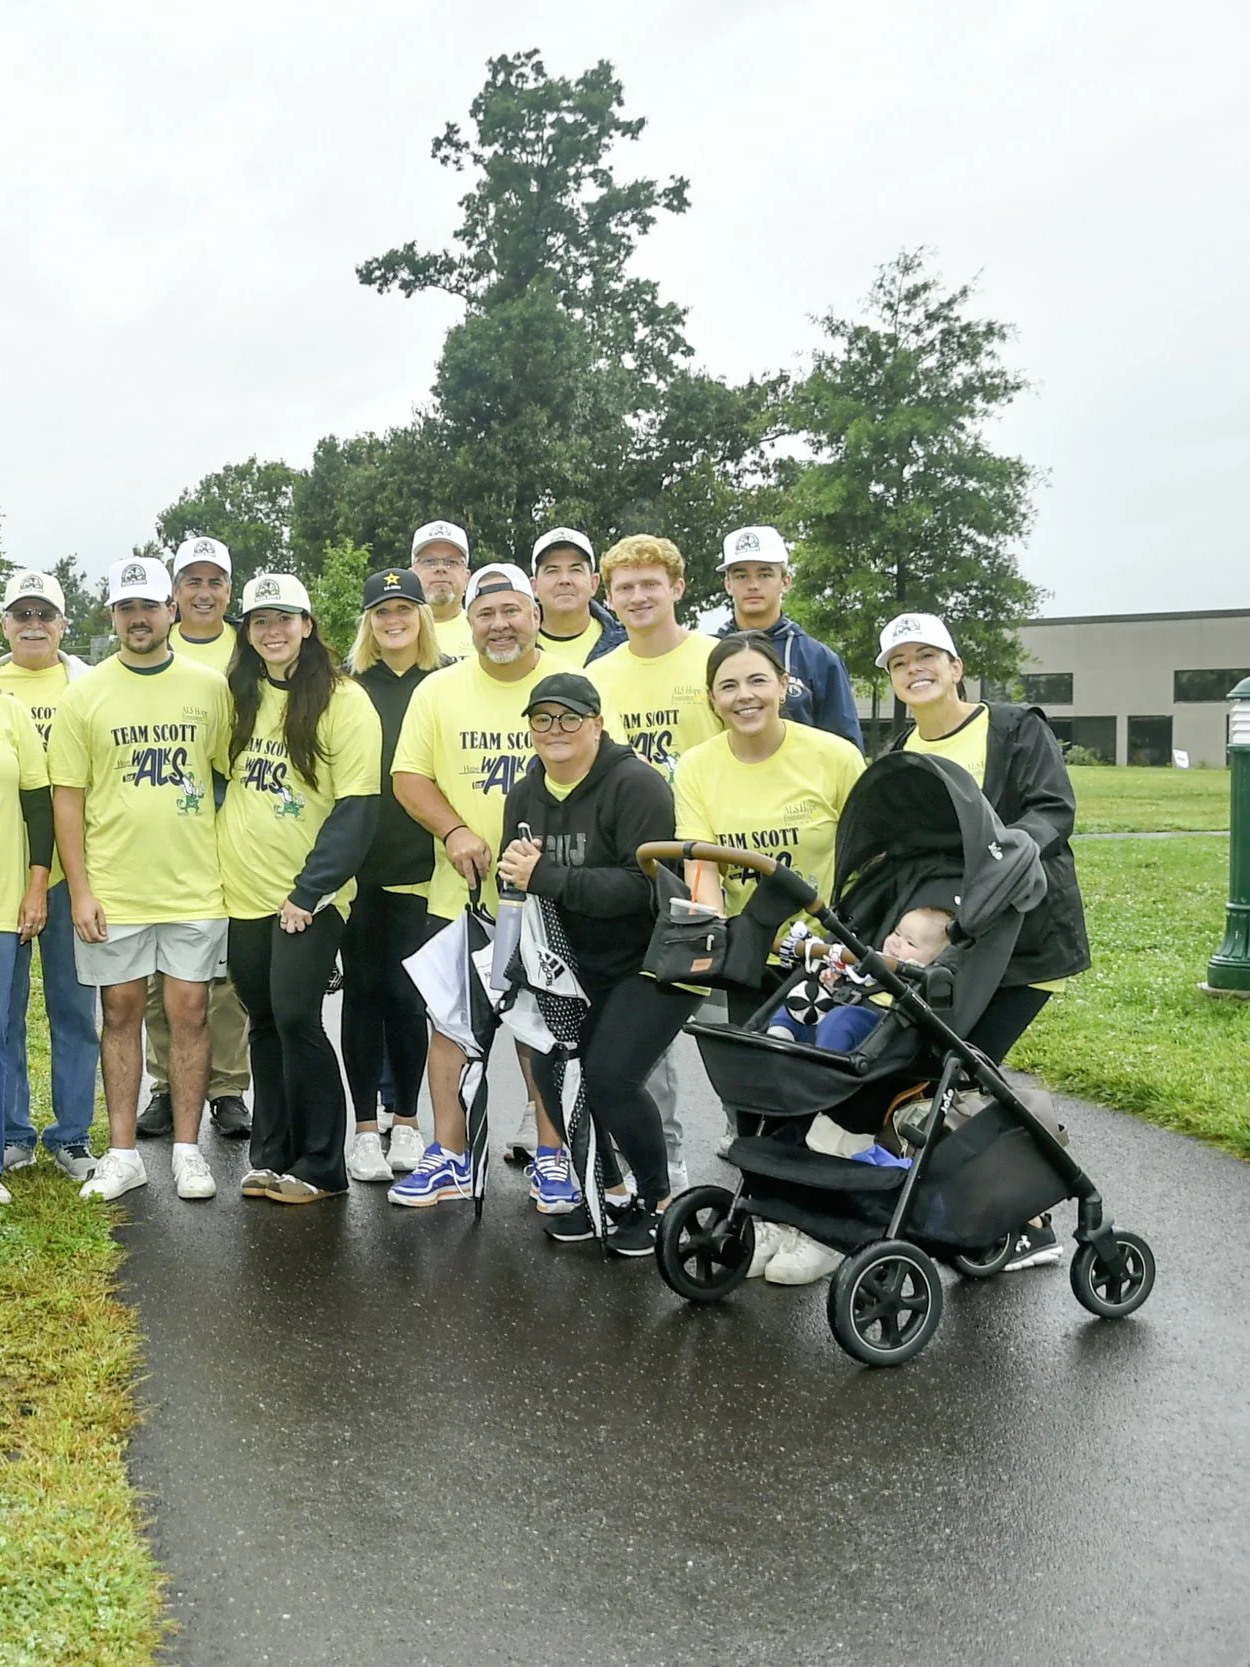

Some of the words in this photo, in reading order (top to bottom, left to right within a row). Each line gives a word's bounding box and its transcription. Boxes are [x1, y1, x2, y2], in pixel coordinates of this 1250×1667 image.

[31, 707, 56, 720] SCO
[623, 713, 641, 729] AM
[111, 725, 149, 746] TEAM
[153, 724, 197, 743] SCOTT
[459, 731, 501, 750] TEAM
[507, 731, 533, 750] SCO
[247, 738, 263, 753] AM
[717, 833, 748, 849] EAM
[752, 827, 799, 848] SCOTT
